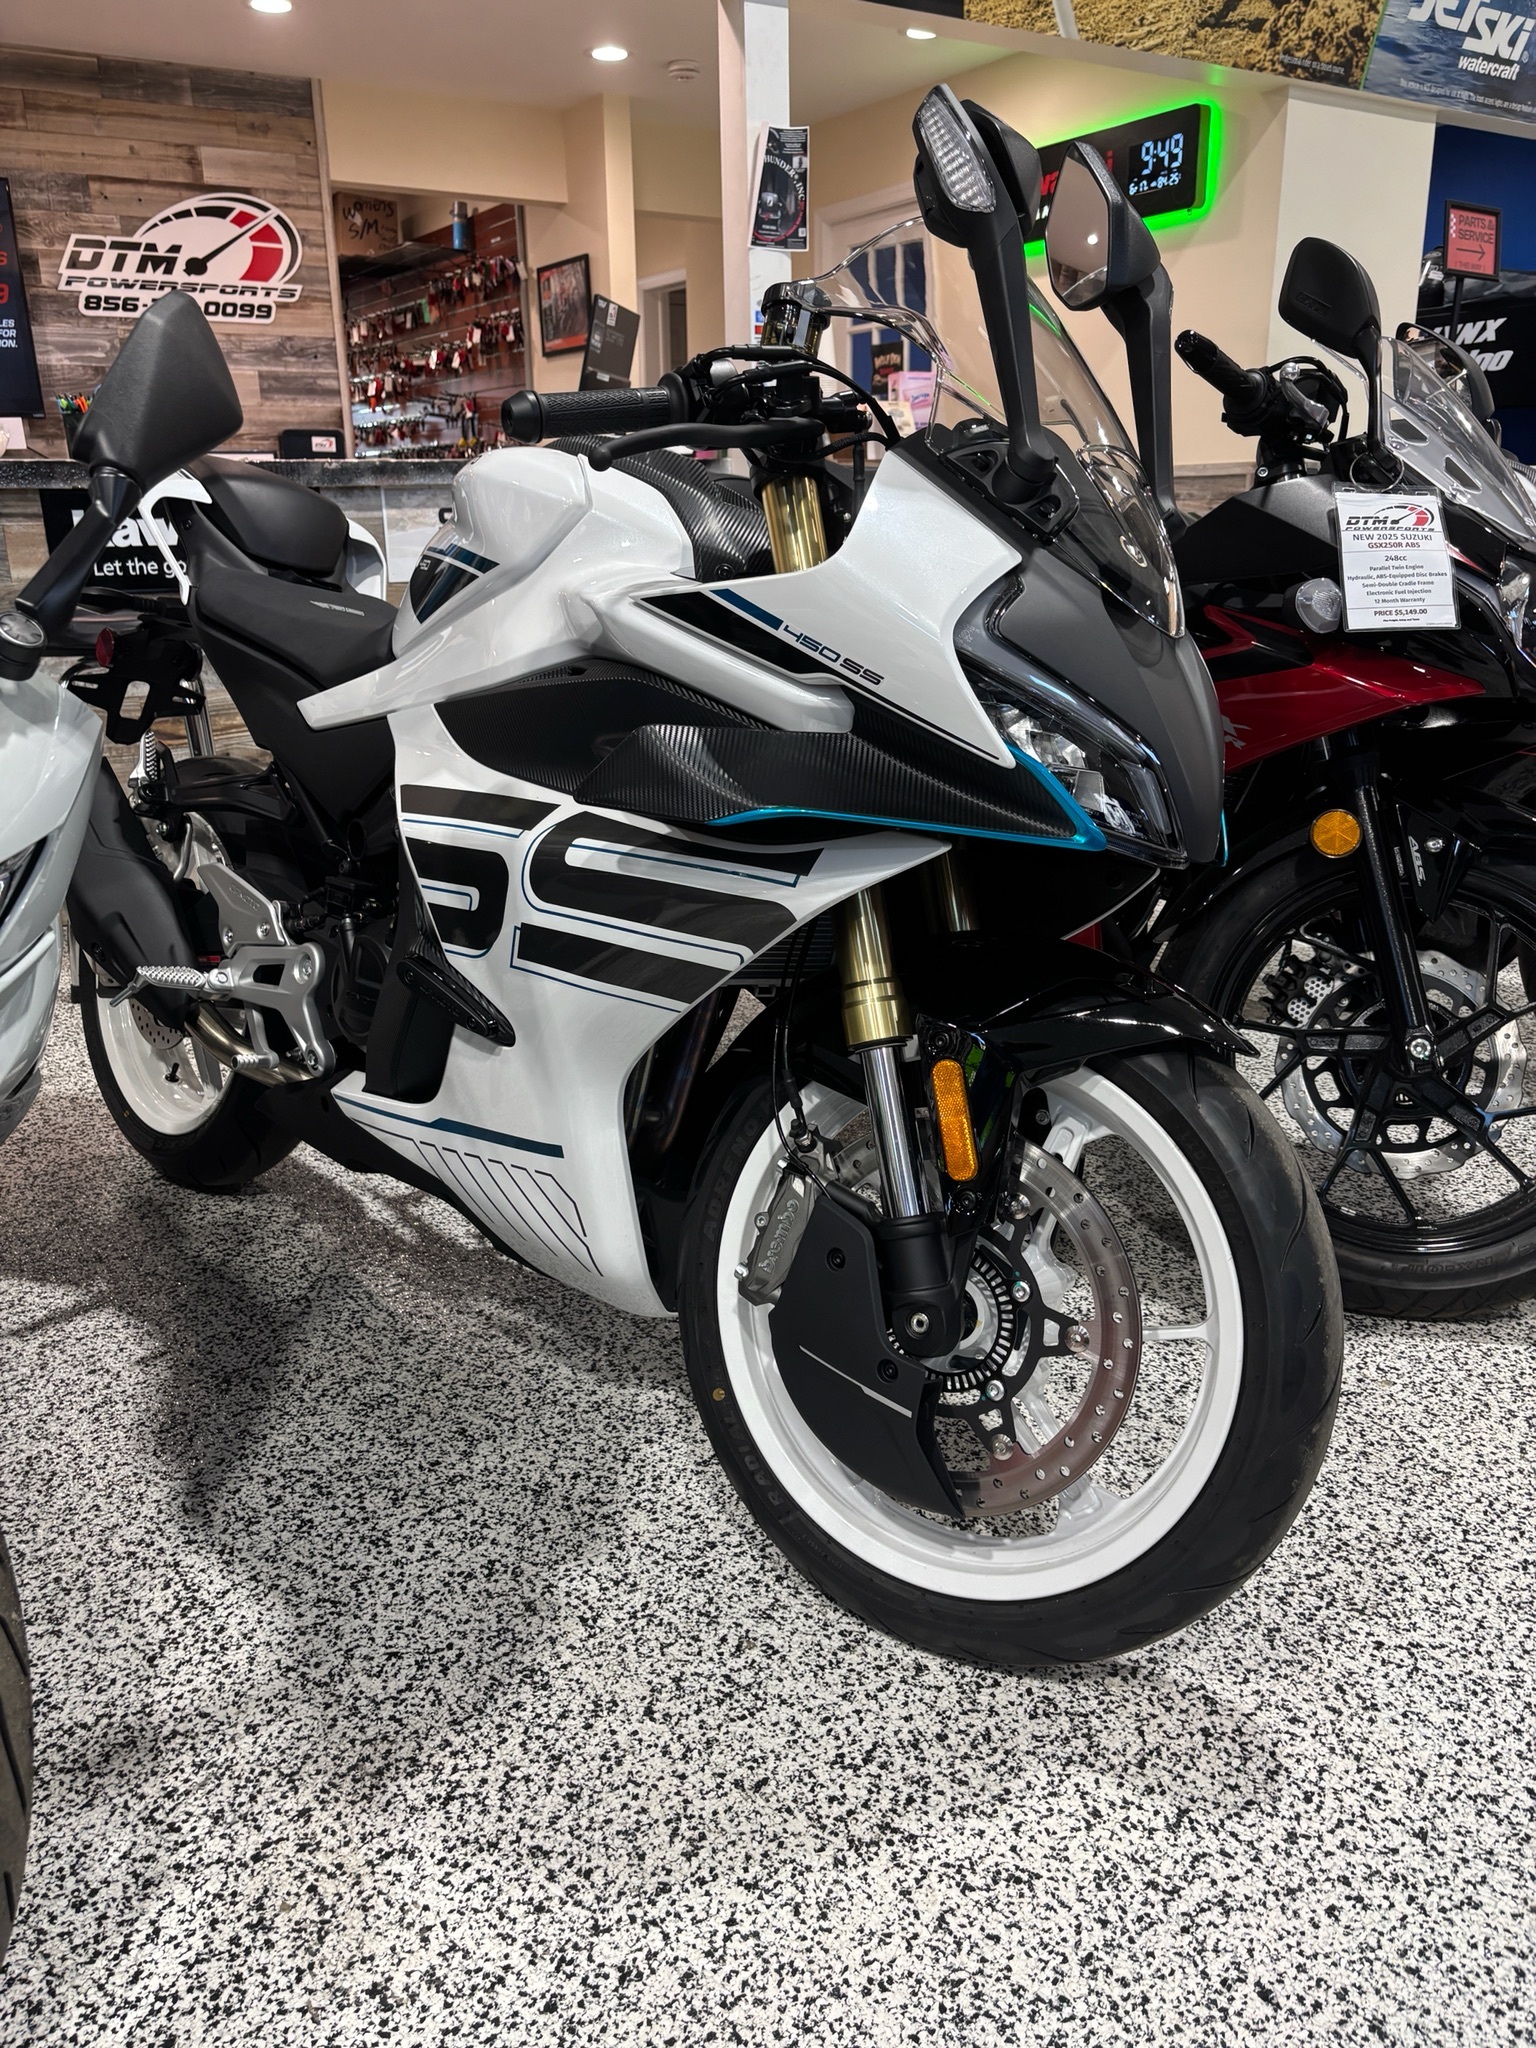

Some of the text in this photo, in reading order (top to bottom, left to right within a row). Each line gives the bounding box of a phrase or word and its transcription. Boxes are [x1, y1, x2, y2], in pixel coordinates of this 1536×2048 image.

[1458, 56, 1520, 81] watercraft
[1141, 132, 1184, 176] 9:49
[1458, 214, 1487, 230] PARTS
[1457, 228, 1495, 245] SERVICE
[65, 238, 183, 275] DTM
[64, 276, 298, 299] POWERSPORTS
[1346, 516, 1389, 525] DTM
[1377, 533, 1398, 541] 2025
[93, 561, 122, 576] Let
[127, 557, 158, 576] the
[1394, 608, 1428, 617] $5,149.00
[782, 624, 885, 686] 450 SS
[1408, 835, 1427, 887] ABS
[723, 1415, 782, 1507] RADIAL
